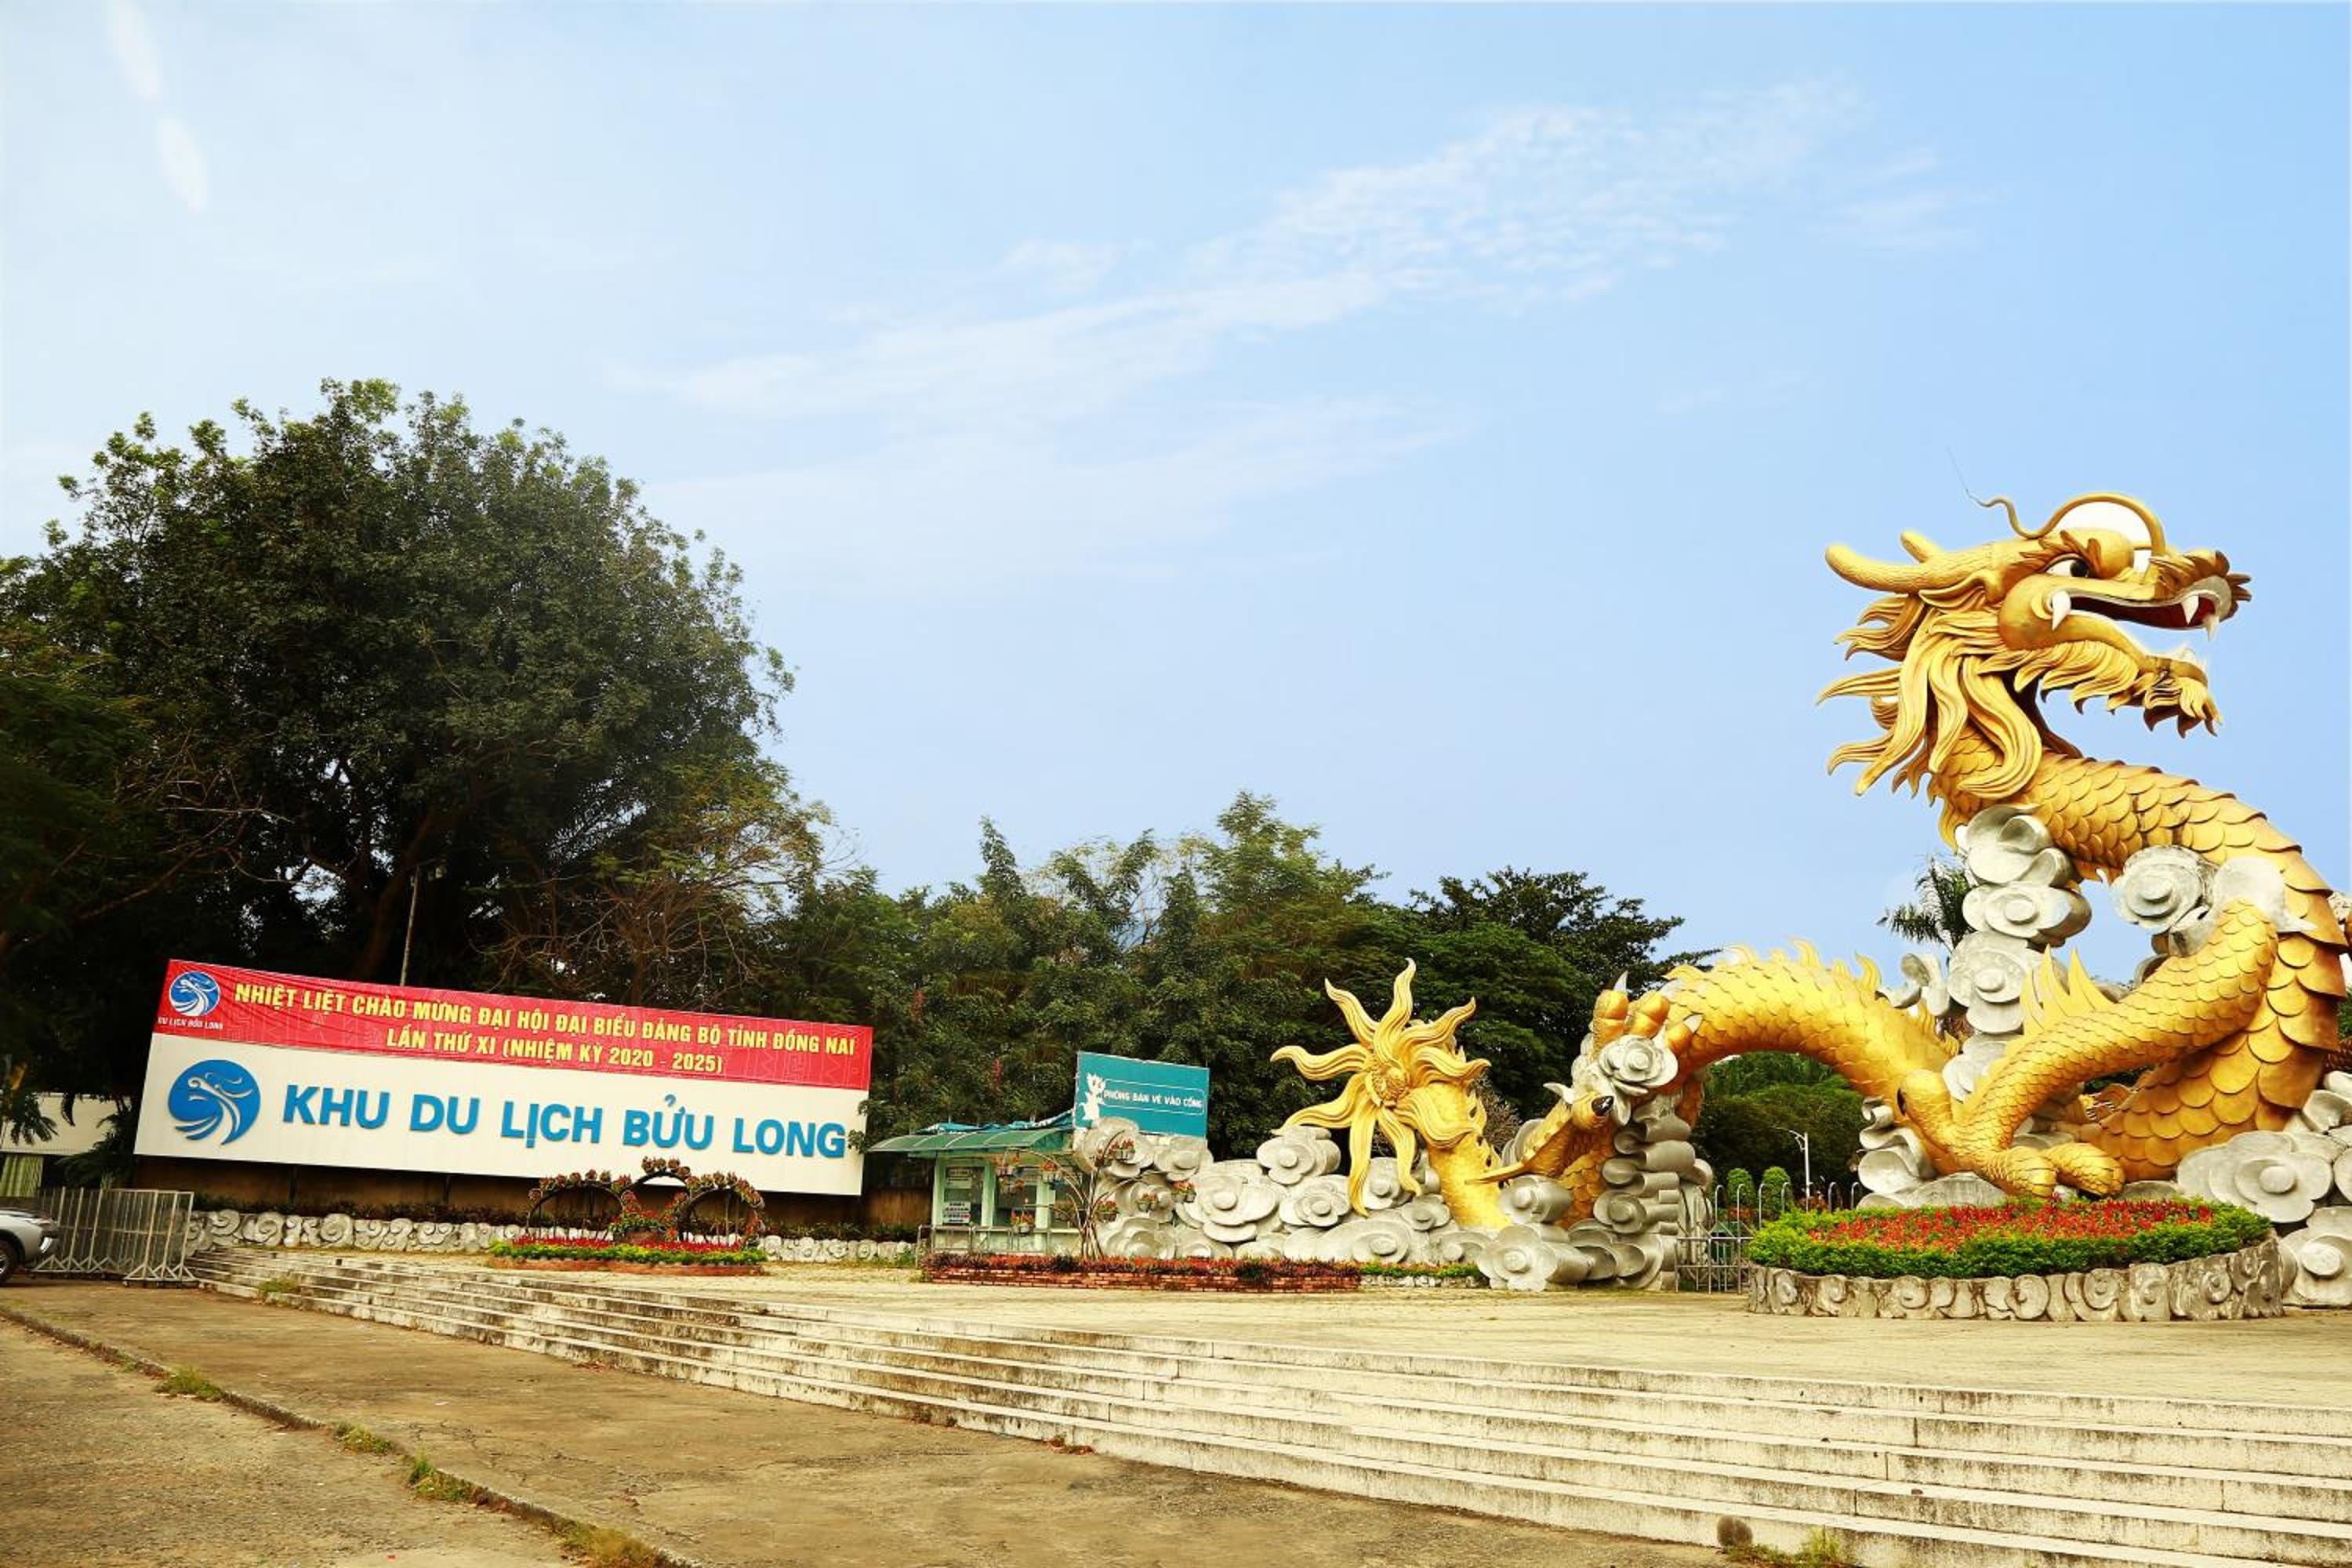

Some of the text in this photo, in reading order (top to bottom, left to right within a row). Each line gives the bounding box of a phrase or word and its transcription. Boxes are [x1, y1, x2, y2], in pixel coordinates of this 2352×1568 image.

[234, 983, 297, 1011] NHIỆT
[303, 989, 347, 1015] LIỆT
[352, 995, 406, 1018] CHÀO
[413, 1000, 472, 1025] MỪNG
[477, 1007, 511, 1031] ĐẠI
[517, 1007, 549, 1034] HỘI
[555, 1014, 587, 1037] ĐẠI
[593, 1012, 636, 1037] BIỂU
[642, 1018, 691, 1042] ĐẢNG
[698, 1024, 721, 1047] BỘ
[728, 1023, 768, 1048] TỈNH
[826, 1036, 855, 1056] NAI
[434, 1031, 472, 1053] THỨ
[476, 1036, 496, 1054] XI
[503, 1037, 573, 1063] (NHIỆM
[579, 1042, 603, 1063] KỲ
[608, 1047, 654, 1067] 2020
[672, 1052, 722, 1073] 2025)
[282, 1084, 846, 1159] KHU DU LỊCH BỬU LONG
